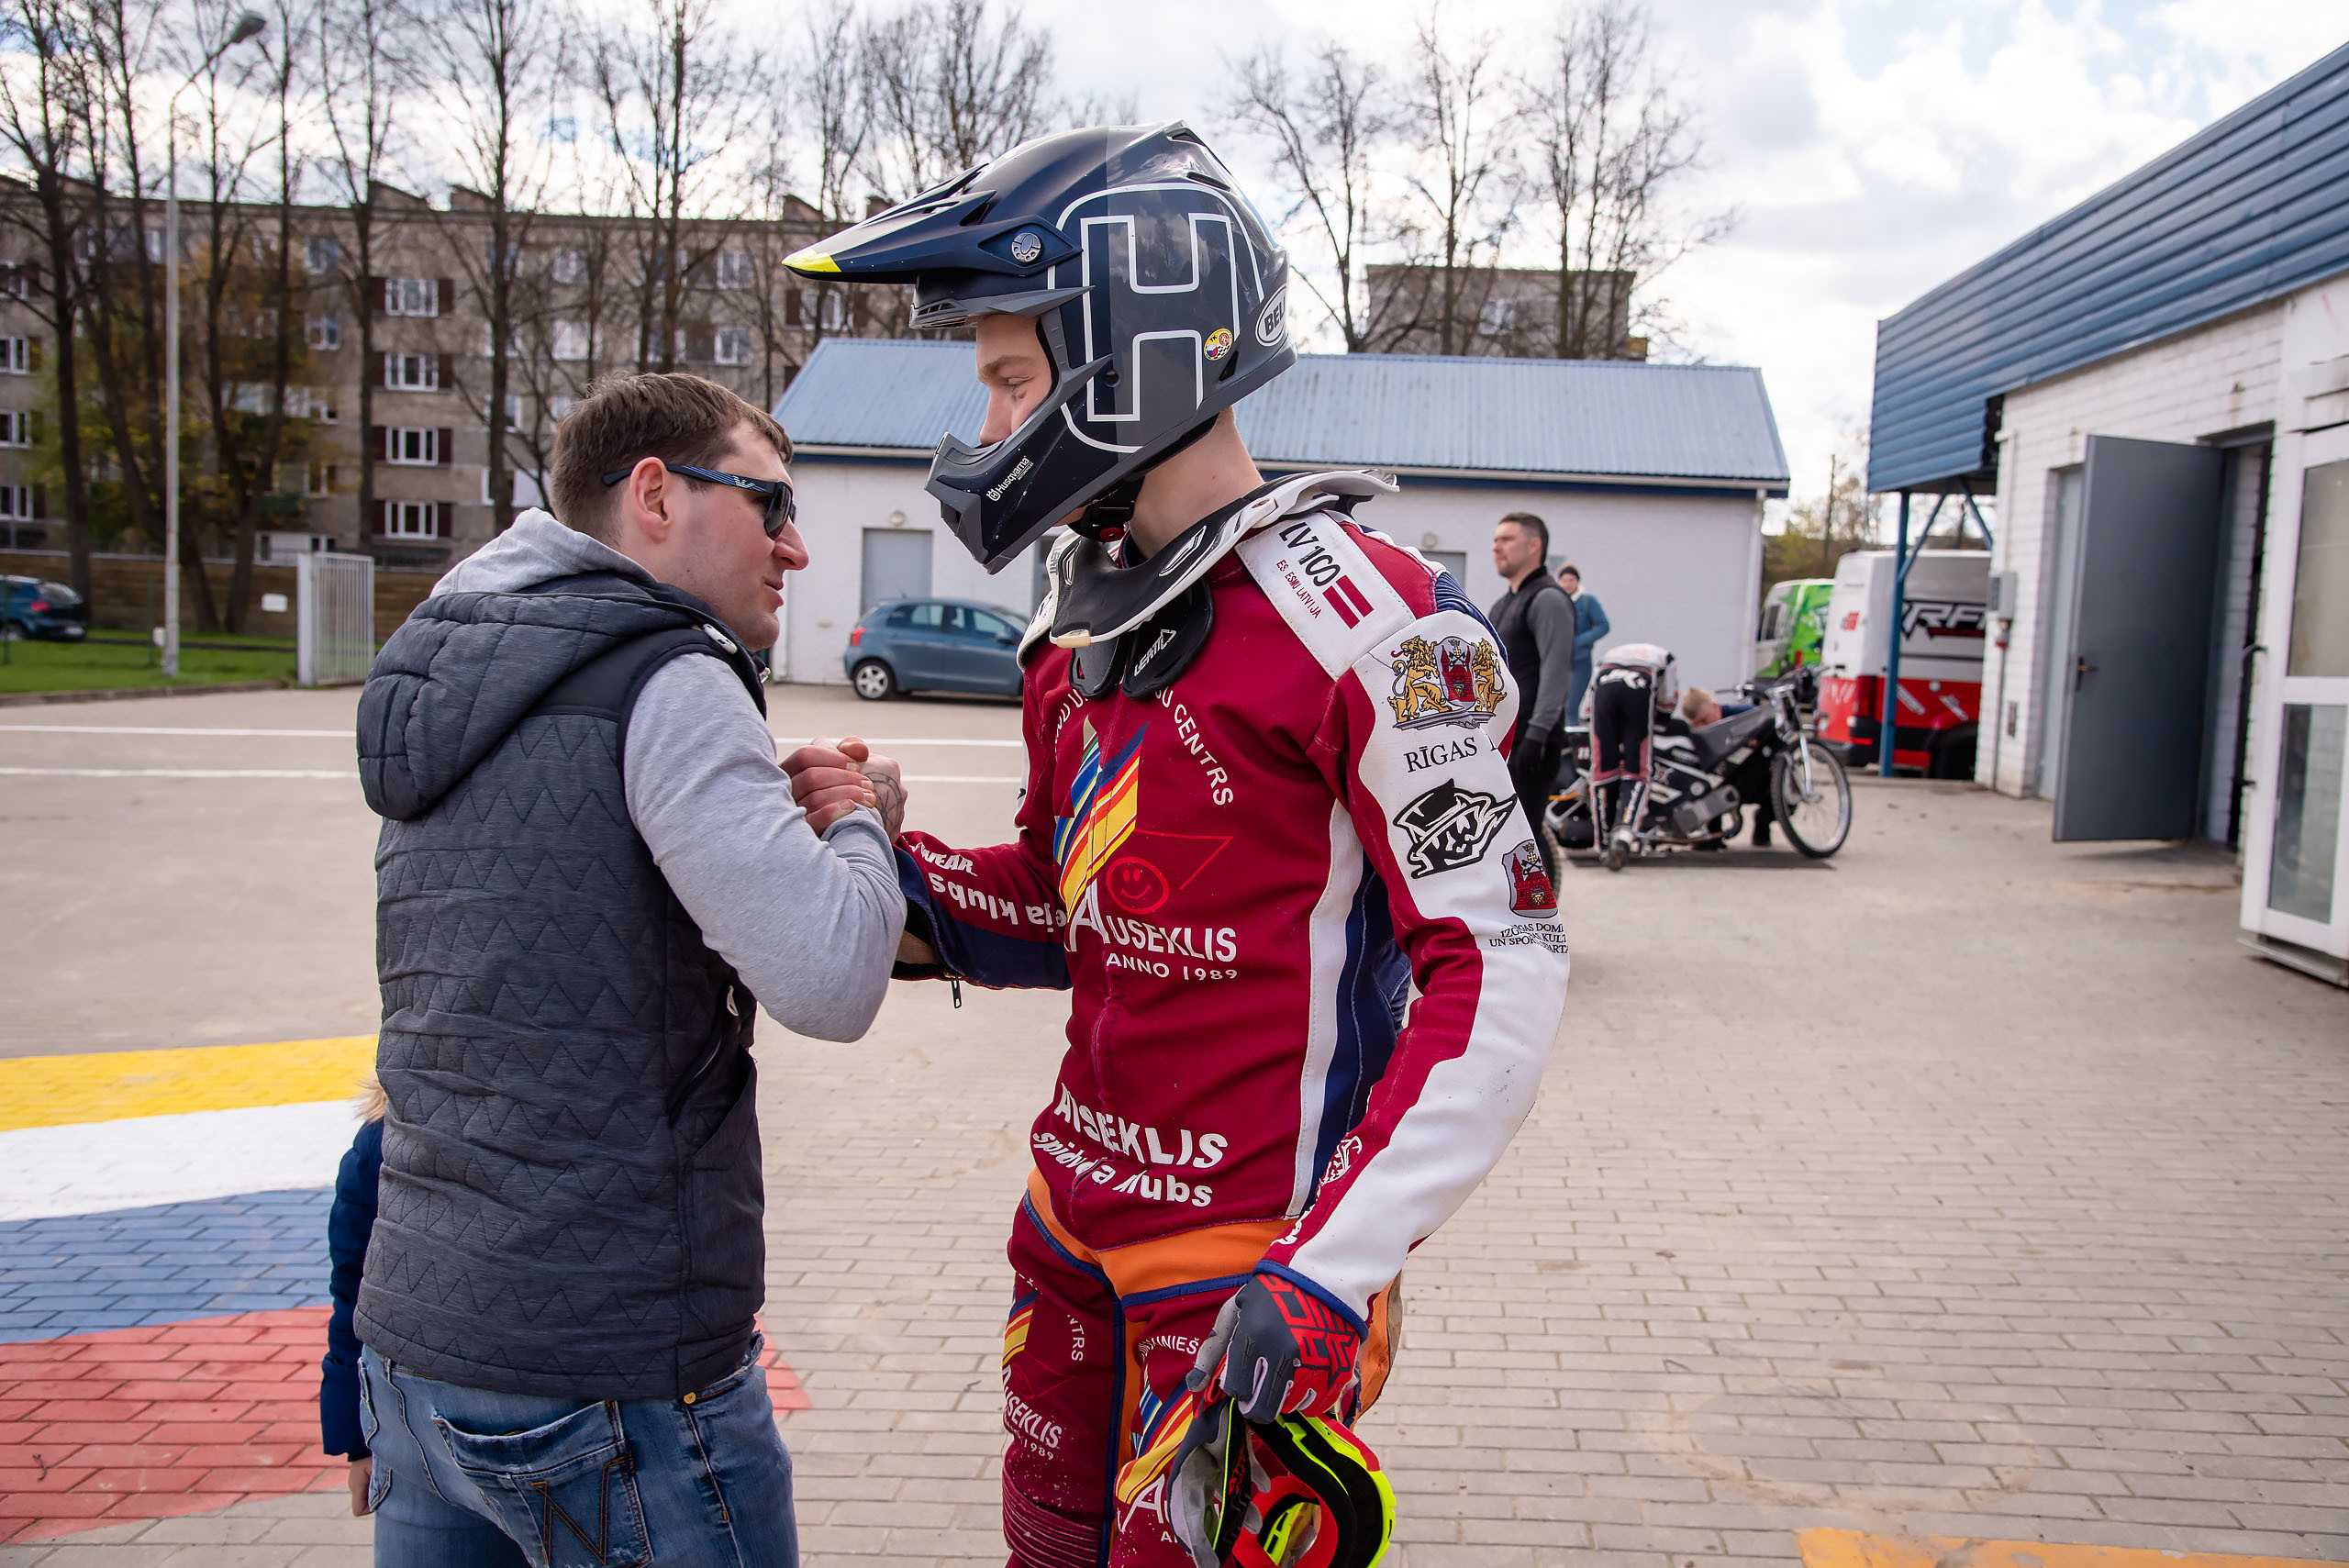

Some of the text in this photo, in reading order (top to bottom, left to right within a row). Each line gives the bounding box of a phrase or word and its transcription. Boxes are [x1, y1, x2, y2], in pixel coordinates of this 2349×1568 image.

[996, 457, 1030, 494] Husqvarna
[1276, 560, 1288, 572] ES
[1296, 587, 1322, 618] LATVIJA
[1174, 704, 1233, 806] CENTRS
[1404, 737, 1477, 773] RĪGAS
[928, 873, 1019, 925] klubs
[1064, 878, 1236, 962] AUSEKLIS
[1489, 939, 1506, 947] UN
[1106, 952, 1238, 981] ANNO 1989
[1023, 1439, 1054, 1461] 1989
